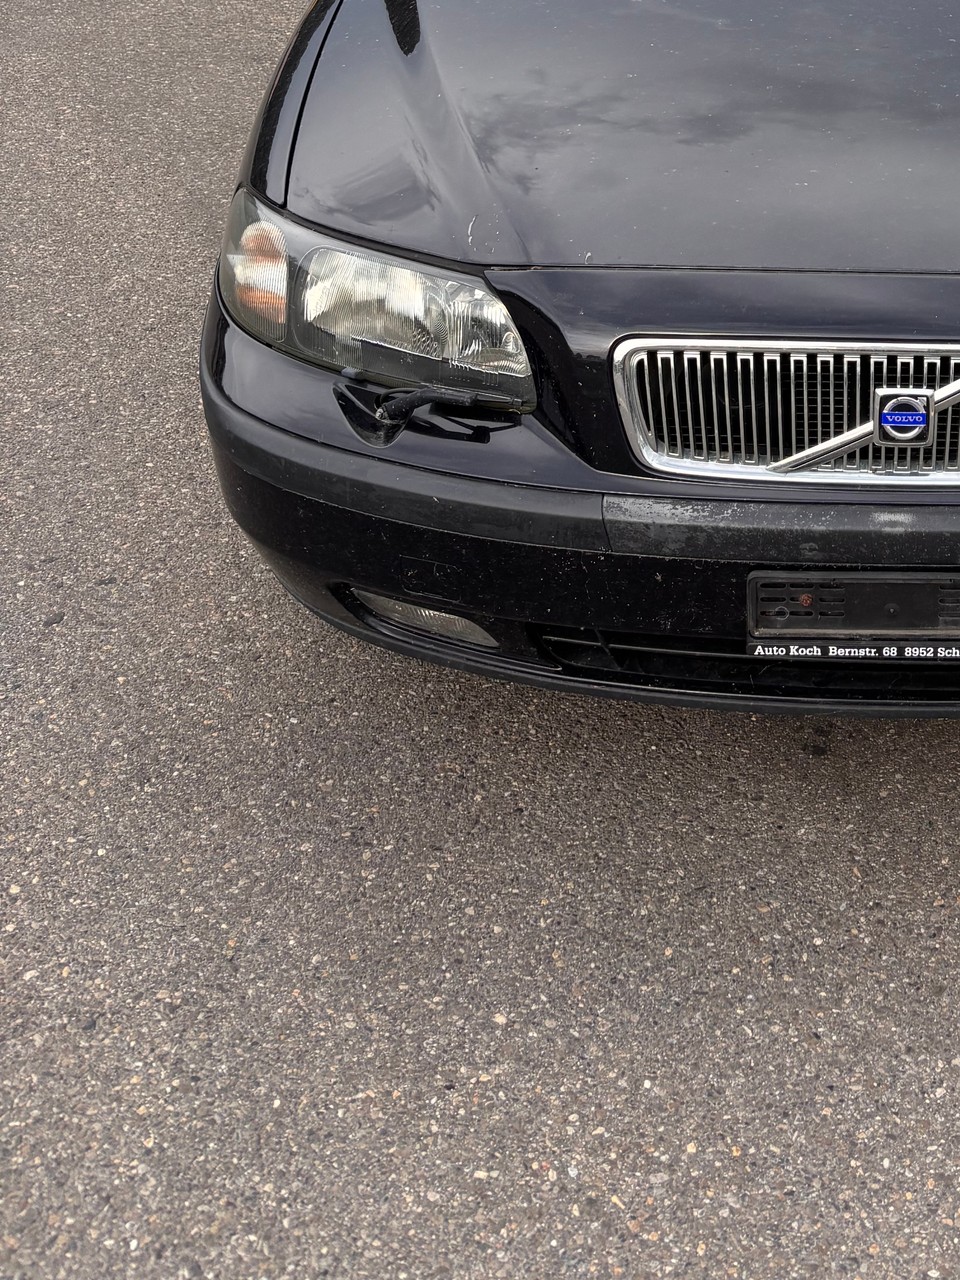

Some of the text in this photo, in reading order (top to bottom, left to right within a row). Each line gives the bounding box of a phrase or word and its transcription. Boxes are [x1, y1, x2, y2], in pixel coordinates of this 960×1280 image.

[754, 645, 786, 656] Auto
[789, 645, 822, 656] Koch
[828, 646, 879, 657] Bernstr.
[882, 646, 898, 657] 68
[904, 647, 934, 657] 8952
